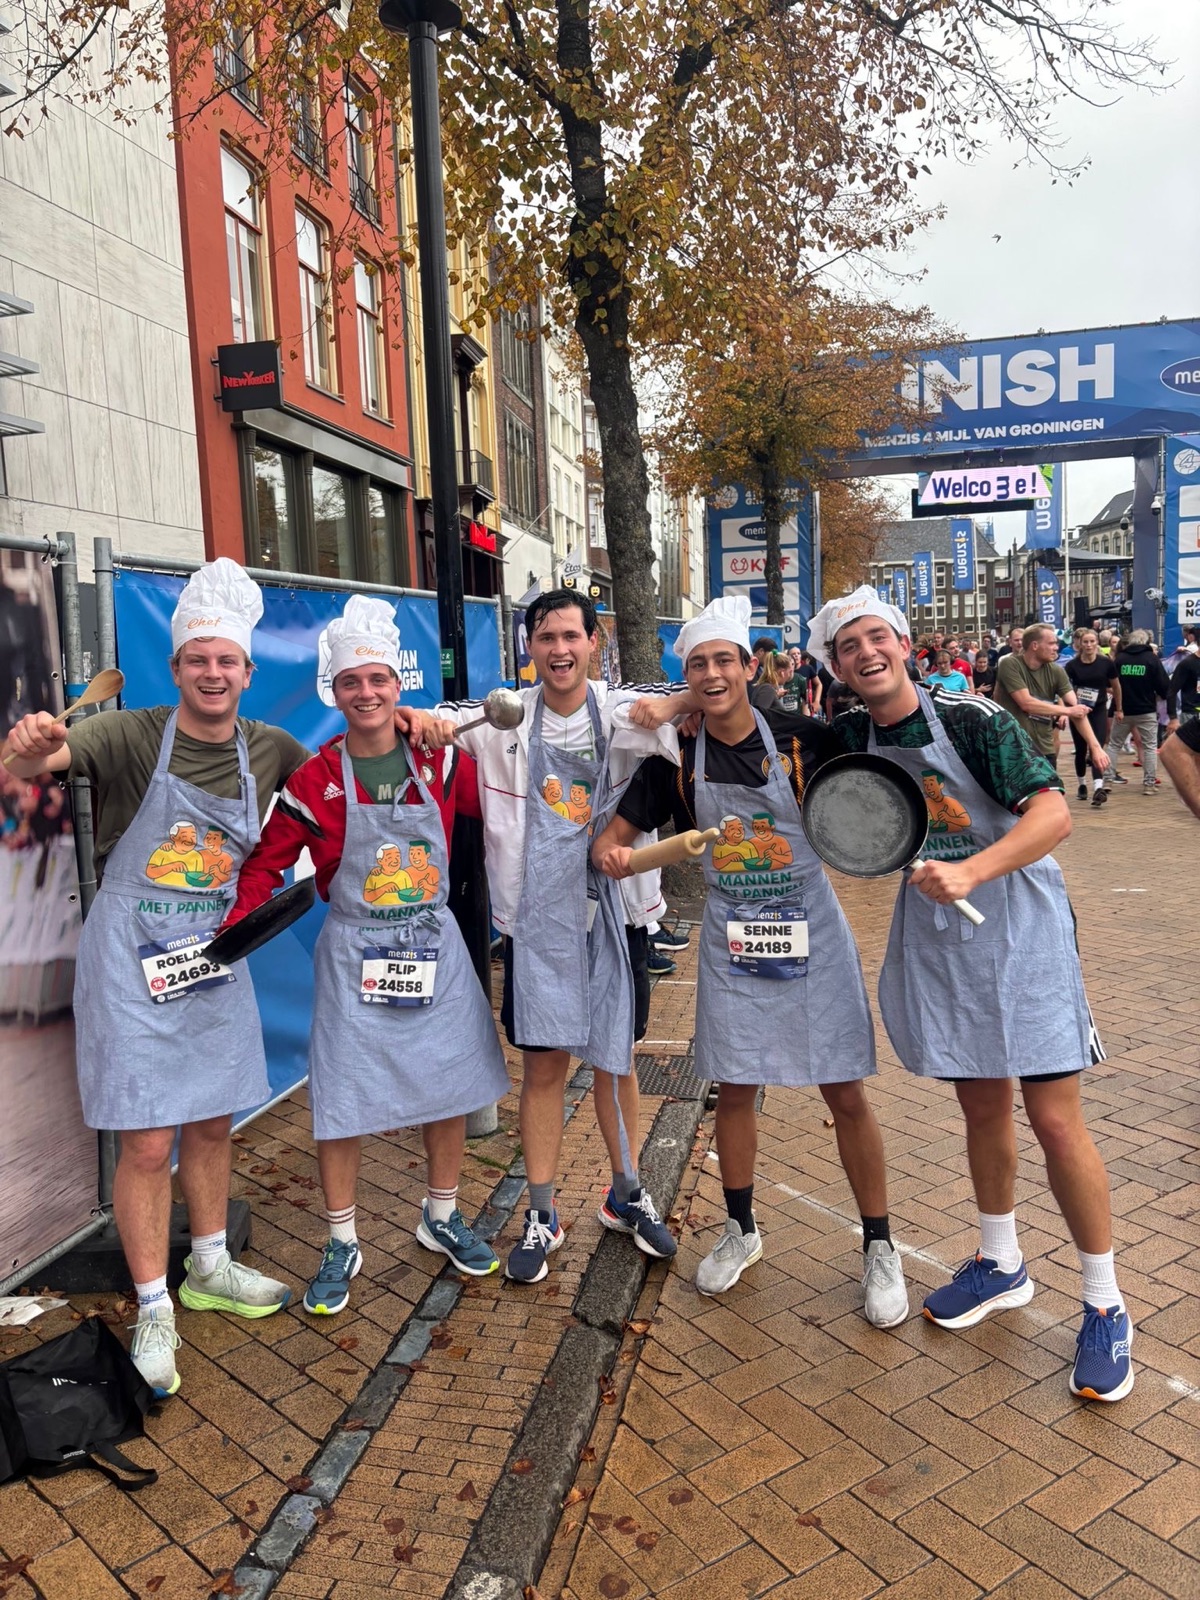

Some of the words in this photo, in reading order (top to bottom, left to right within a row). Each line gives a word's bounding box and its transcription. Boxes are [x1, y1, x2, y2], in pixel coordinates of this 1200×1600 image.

[899, 343, 1115, 414] INISH
[865, 432, 921, 448] MENZIS
[922, 431, 932, 443] 4
[935, 428, 972, 442] MIJL
[974, 425, 1007, 440] VAN
[1010, 417, 1104, 437] GRONINGEN
[744, 526, 766, 536] men
[751, 556, 791, 573] KF
[837, 599, 867, 618] Chef
[187, 616, 222, 630] Chef
[355, 645, 387, 658] Chef
[1121, 664, 1146, 675] GOLAZO
[400, 670, 424, 692] GEN
[922, 834, 976, 851] NNEN
[718, 871, 792, 887] MANNEN
[138, 899, 173, 915] MET
[756, 910, 782, 920] enzis
[743, 925, 792, 936] SENNE
[166, 933, 200, 950] menzis
[744, 941, 792, 954] 24189
[156, 948, 206, 970] ROELA
[388, 949, 418, 960] menzis
[165, 960, 221, 988] 24693
[387, 963, 417, 975] FLIP
[377, 978, 423, 993] 24558
